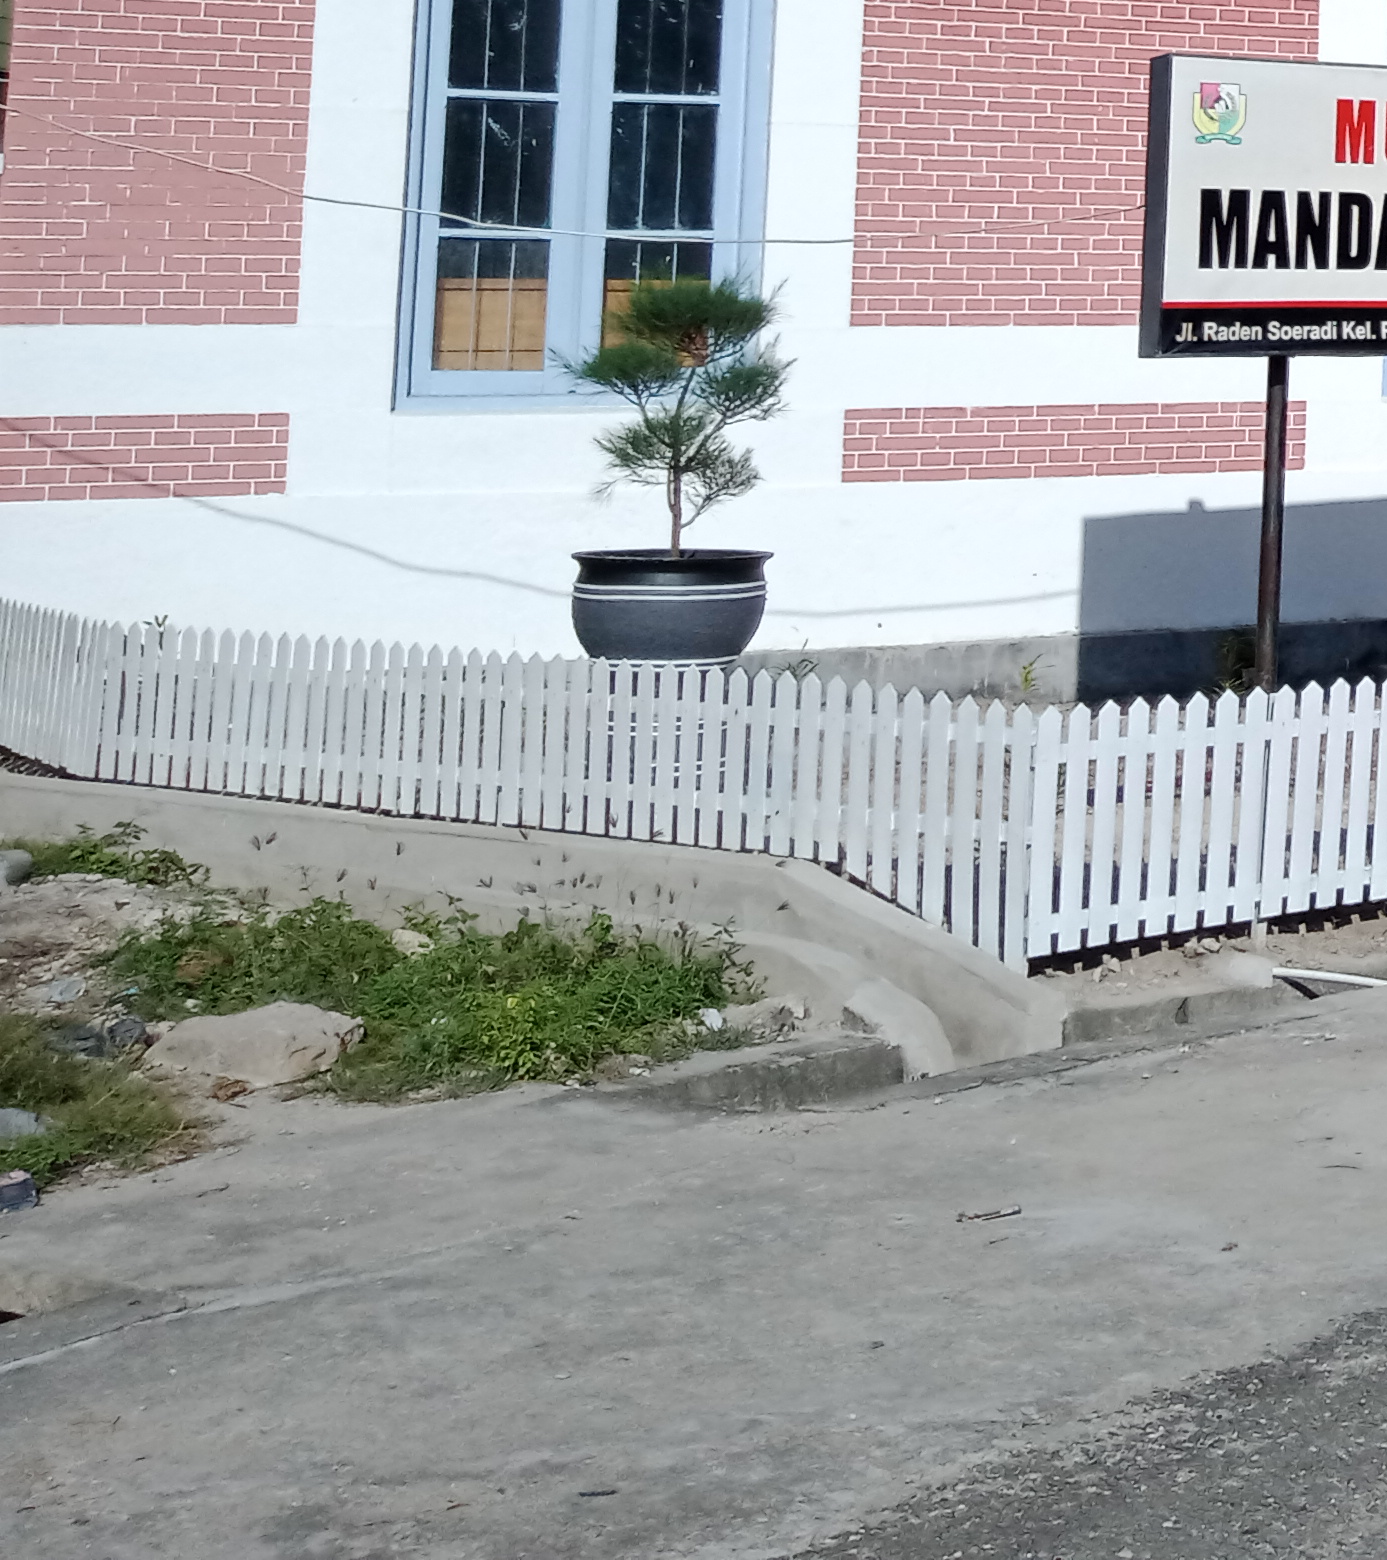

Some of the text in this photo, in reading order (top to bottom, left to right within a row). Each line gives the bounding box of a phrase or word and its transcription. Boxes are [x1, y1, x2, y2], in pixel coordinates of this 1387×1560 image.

[1175, 322, 1198, 342] Jl.
[1203, 321, 1263, 341] Raden
[1267, 320, 1338, 341] Soeradi
[1341, 320, 1377, 340] Kel.
